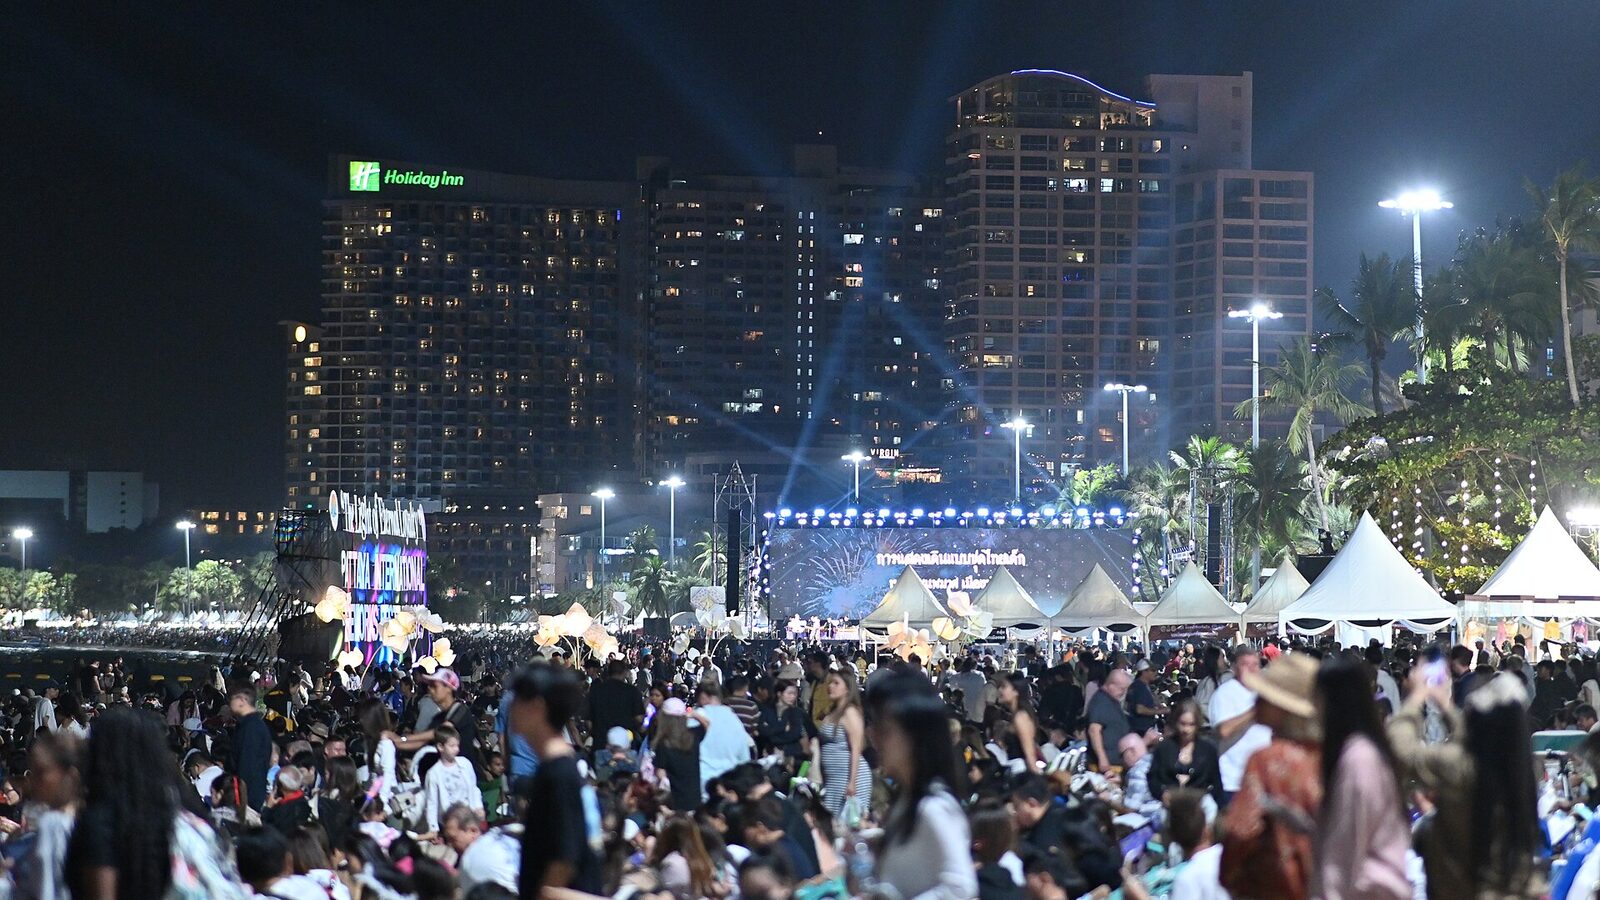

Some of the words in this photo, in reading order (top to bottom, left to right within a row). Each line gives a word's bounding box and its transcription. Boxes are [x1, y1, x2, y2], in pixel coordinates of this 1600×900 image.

[384, 169, 440, 189] Holiday
[441, 170, 464, 186] Inn
[870, 448, 899, 457] VIRGIN
[372, 491, 379, 540] of
[341, 549, 371, 590] PATTAYA
[373, 553, 425, 592] INTERNATIONAL
